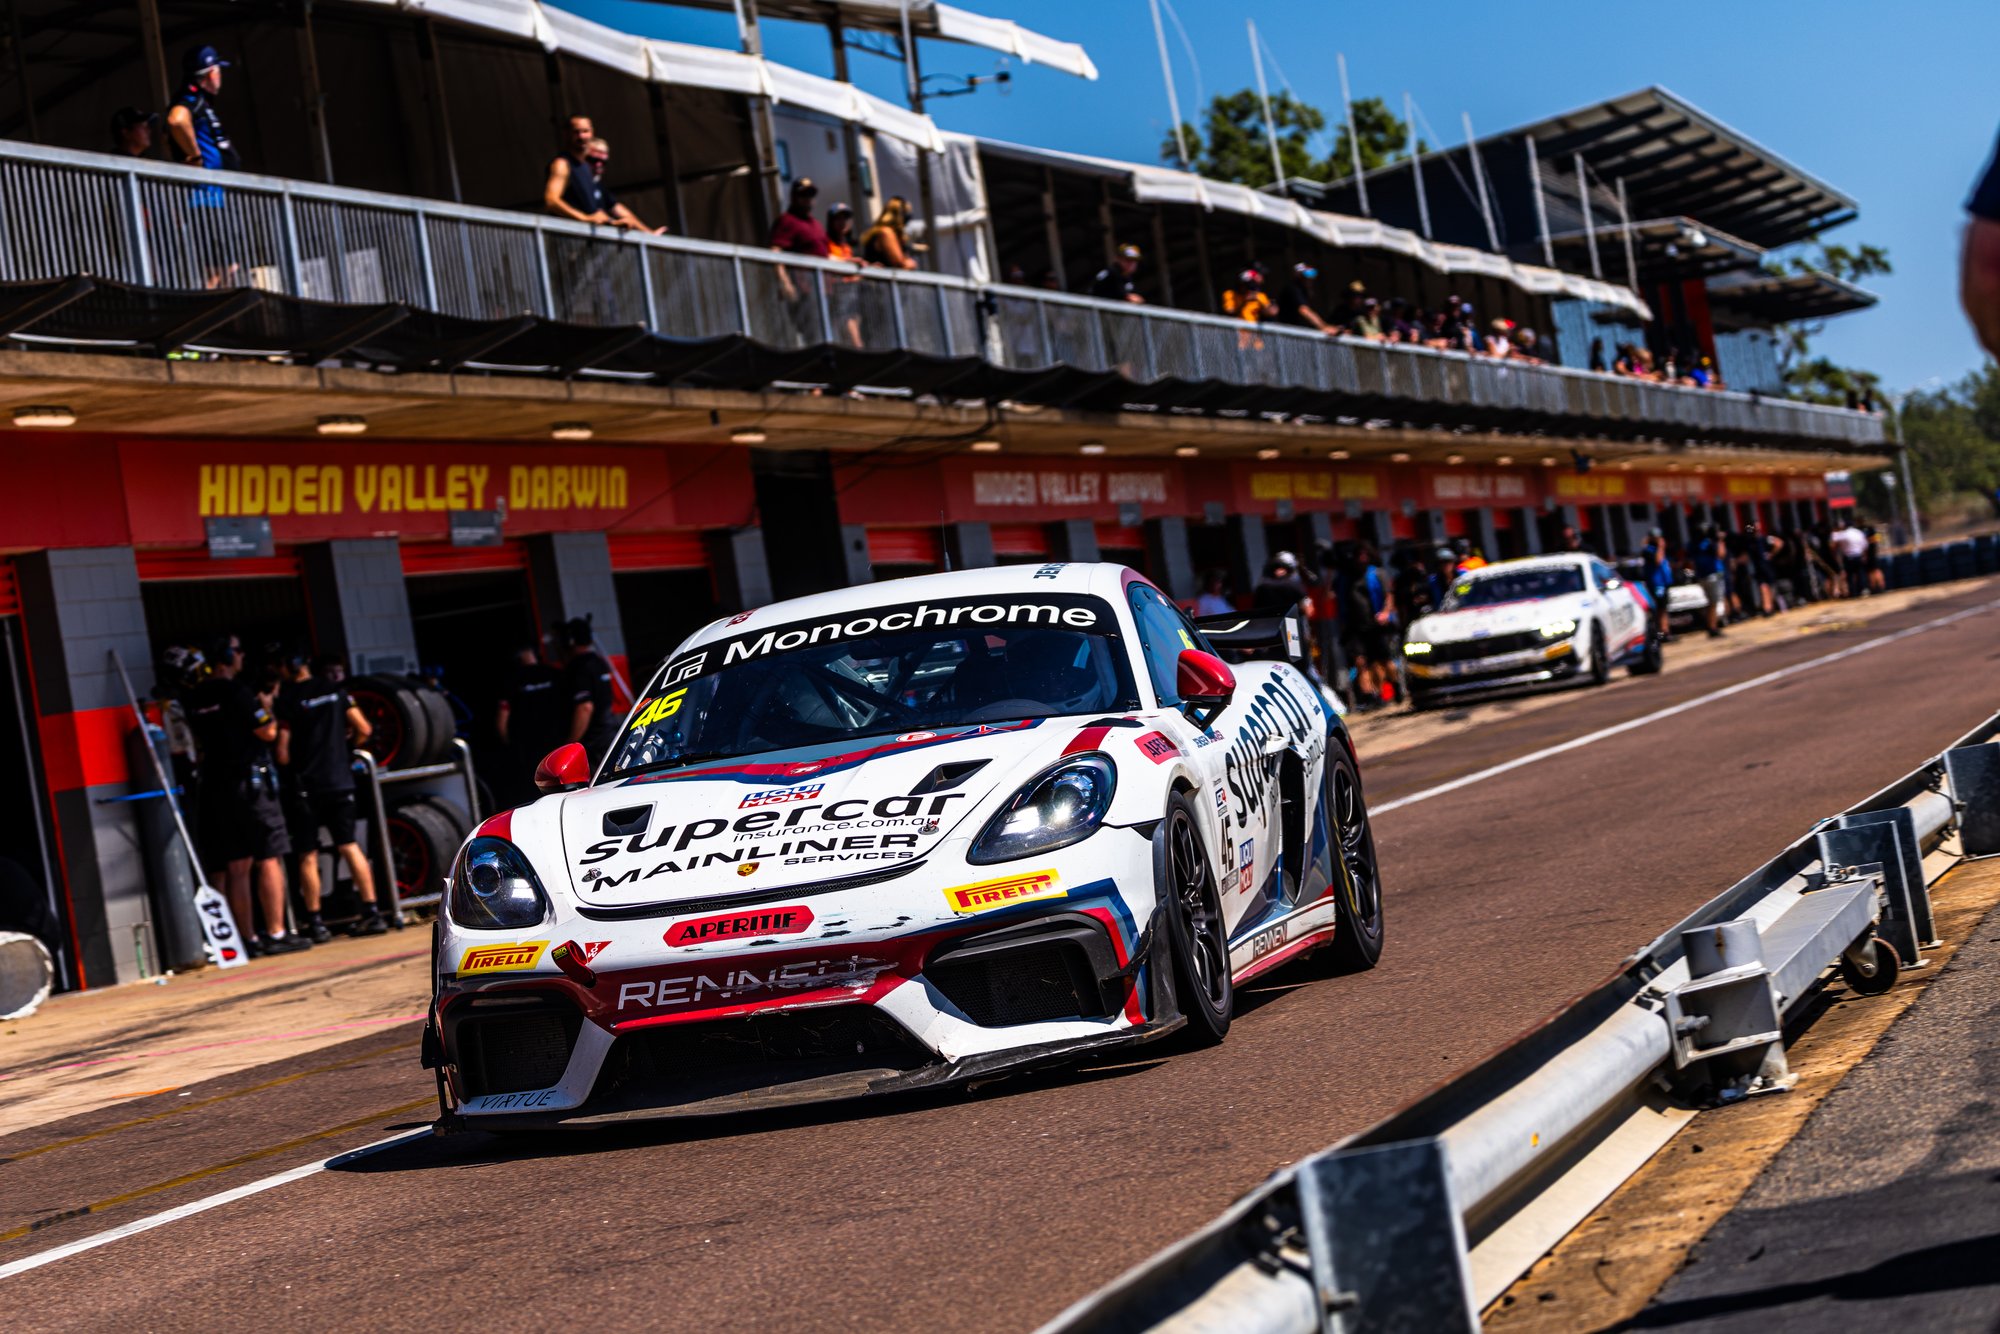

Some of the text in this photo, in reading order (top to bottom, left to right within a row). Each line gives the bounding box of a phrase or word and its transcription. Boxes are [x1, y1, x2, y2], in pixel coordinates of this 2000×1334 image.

[200, 465, 627, 516] HIDDEN VALLEY DARWIN
[722, 604, 1097, 665] Monochrome
[630, 687, 688, 730] 46
[742, 791, 818, 808] MOLY
[747, 784, 822, 801] LIQUI
[580, 793, 965, 865] supercar
[733, 818, 940, 843] insurance.com.au
[591, 834, 919, 893] MAINLINER
[784, 851, 914, 865] SERVICES
[954, 875, 1052, 908] PIRELLI
[679, 912, 797, 941] APERITIF
[463, 946, 539, 970] PIRELLI
[480, 1090, 556, 1109] VIRTUE
